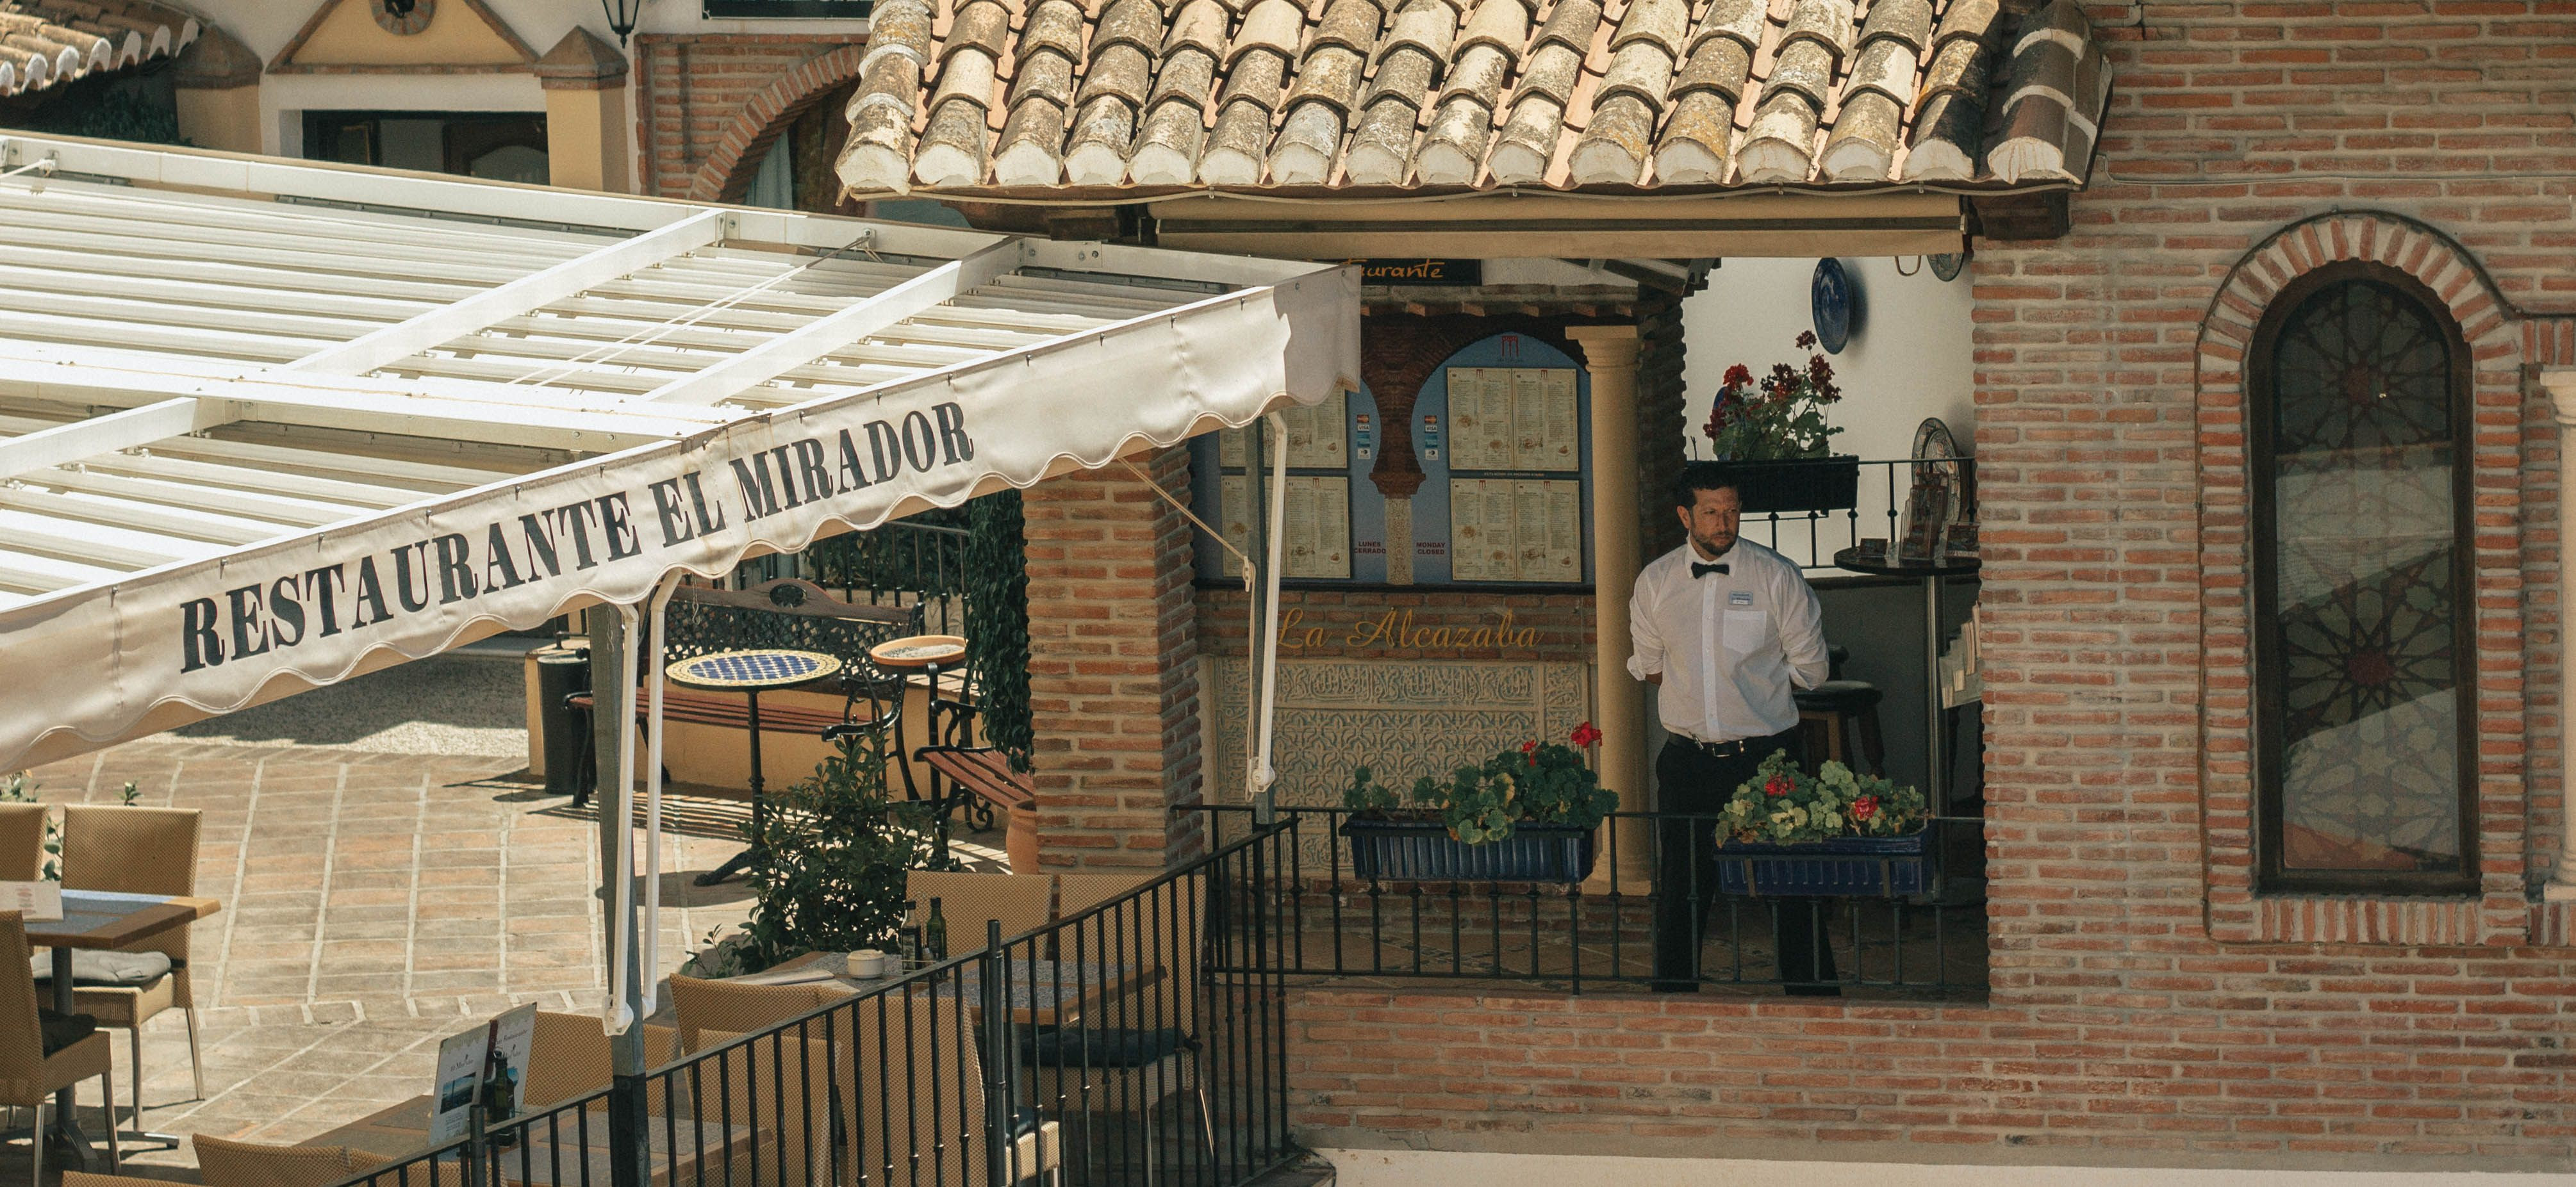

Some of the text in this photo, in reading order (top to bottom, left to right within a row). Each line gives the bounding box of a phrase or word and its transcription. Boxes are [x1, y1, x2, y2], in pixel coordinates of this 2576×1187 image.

[179, 401, 975, 675] RESTAURANTE EL MIRADOR
[1277, 607, 1544, 649] La Alcazaba
